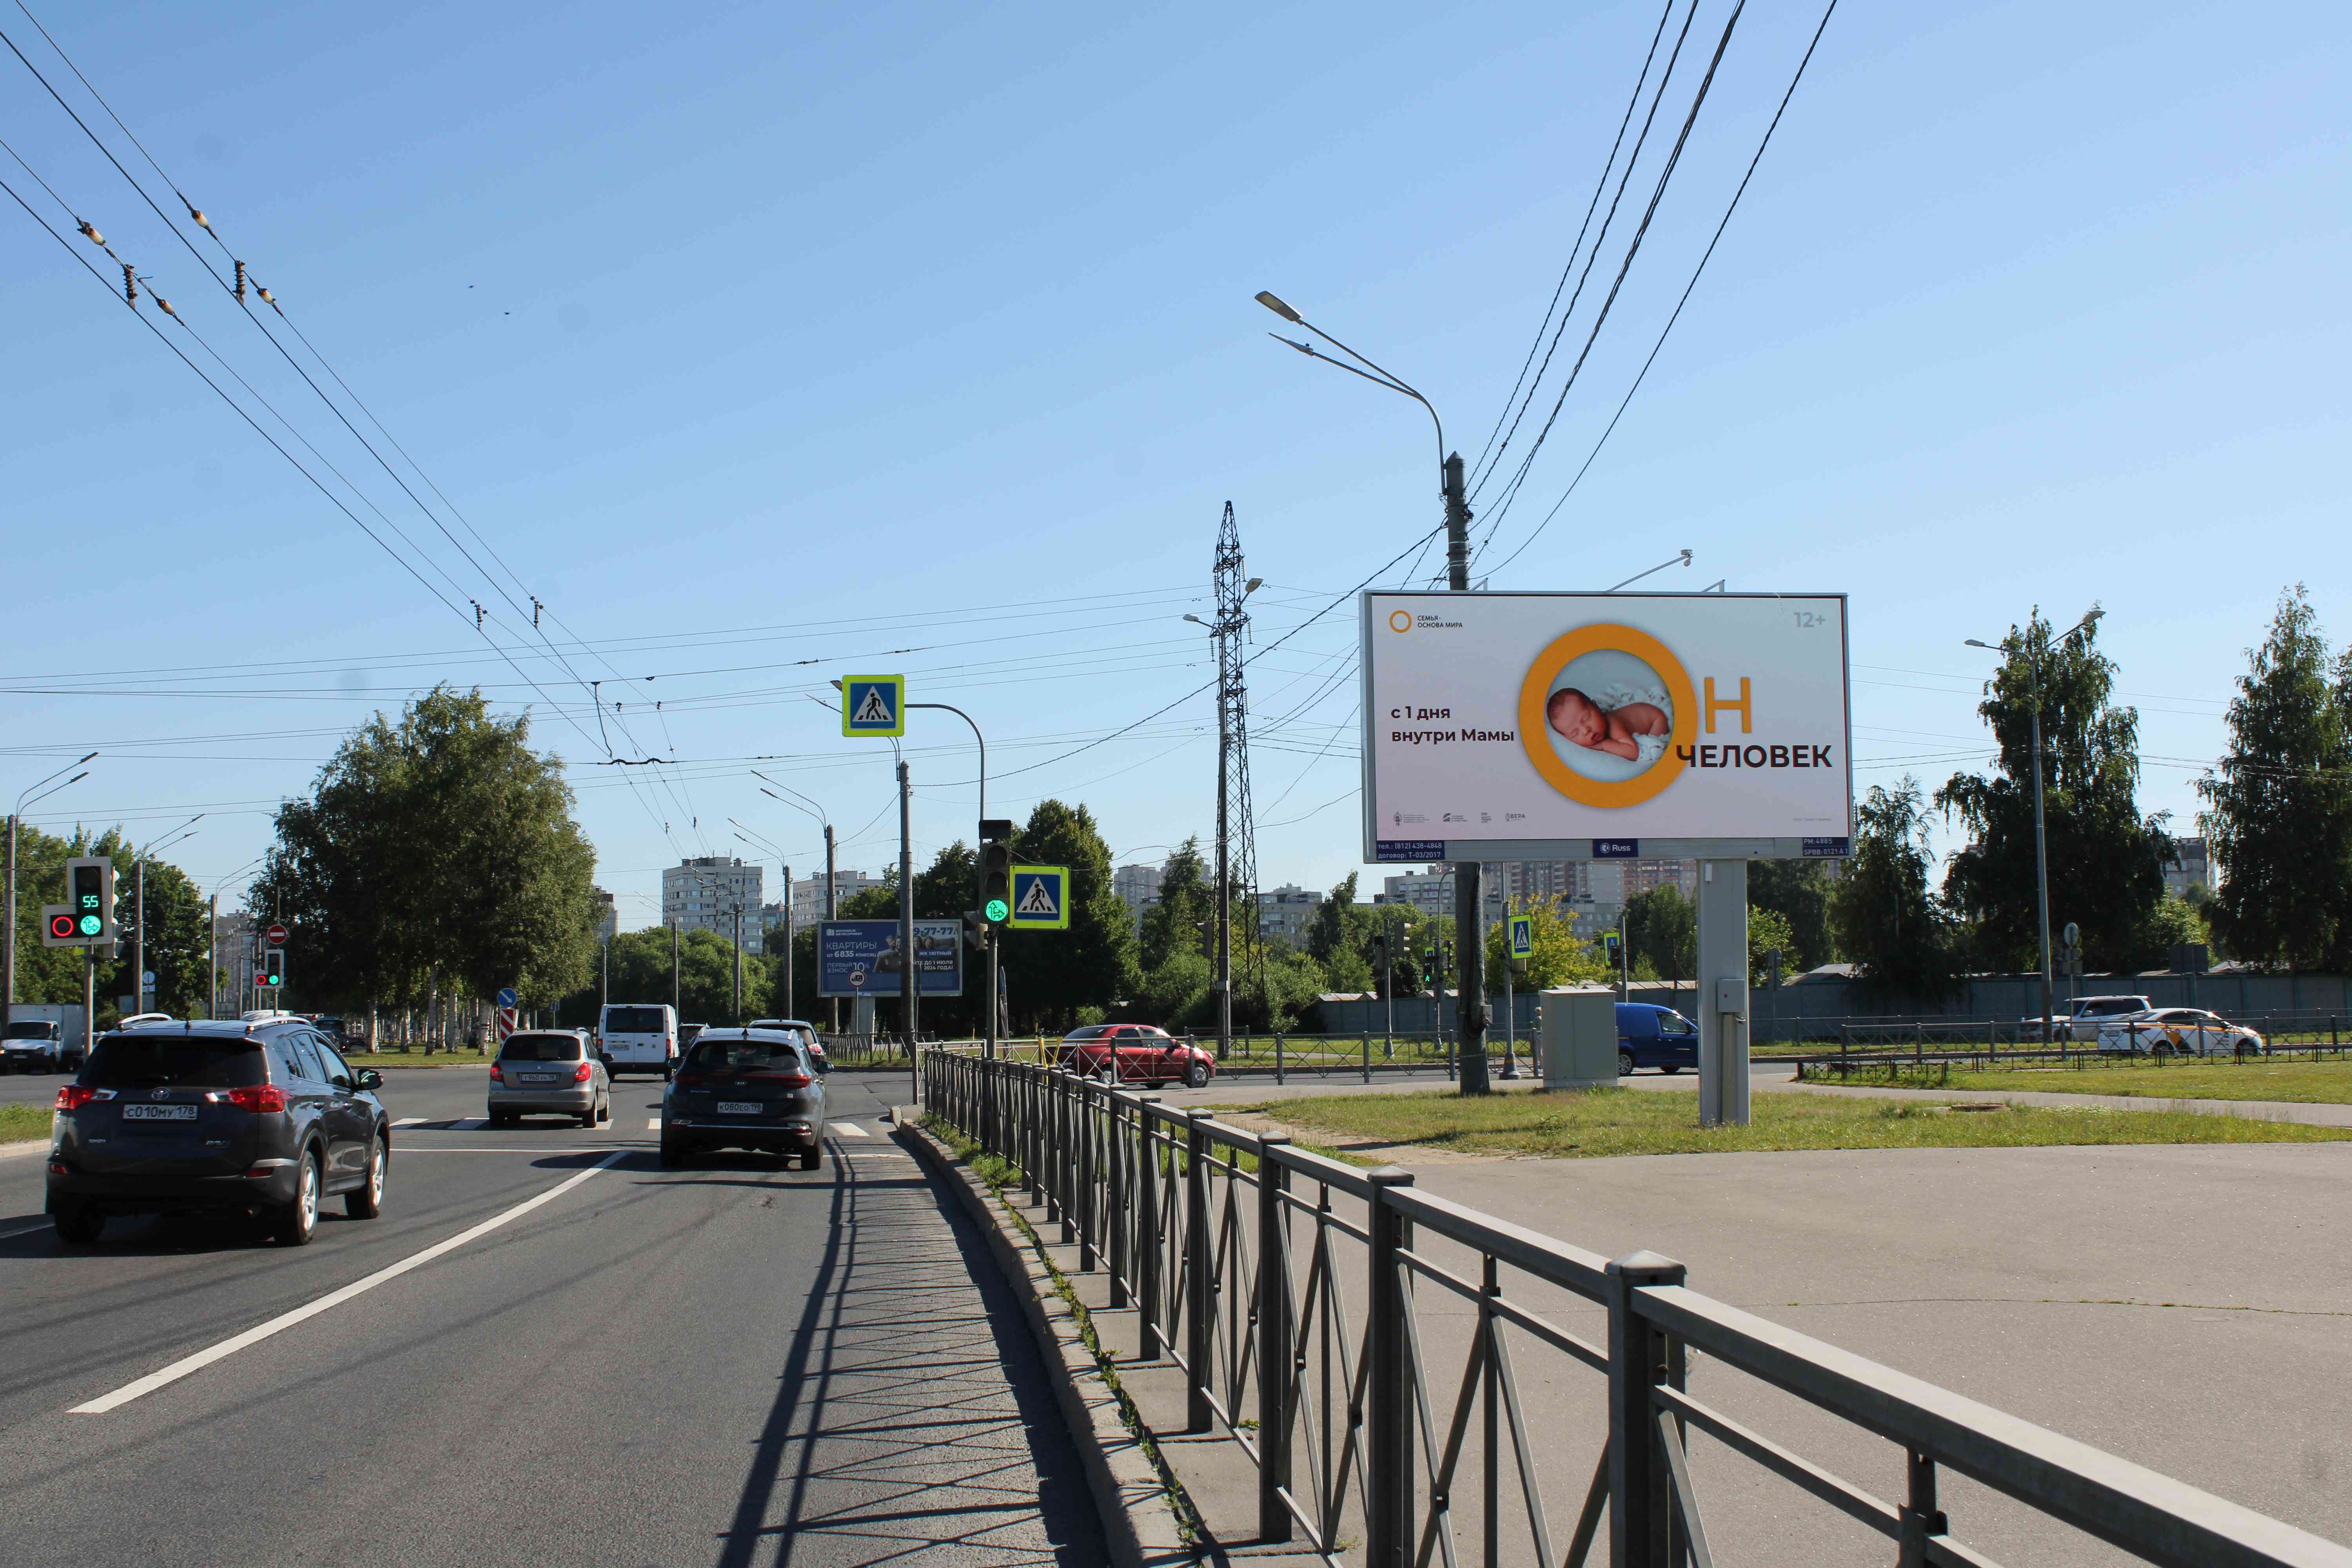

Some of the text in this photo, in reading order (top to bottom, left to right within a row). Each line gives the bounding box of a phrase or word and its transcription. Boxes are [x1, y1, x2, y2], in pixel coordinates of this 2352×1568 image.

[1794, 612, 1826, 628] 12+
[1391, 706, 1450, 720] с 1 дня
[1392, 729, 1514, 745] внутри Мамы
[1676, 745, 1832, 768] ЧЕЛОВЕК
[83, 896, 98, 907] 55
[826, 942, 877, 950] КВАРТИРЫ
